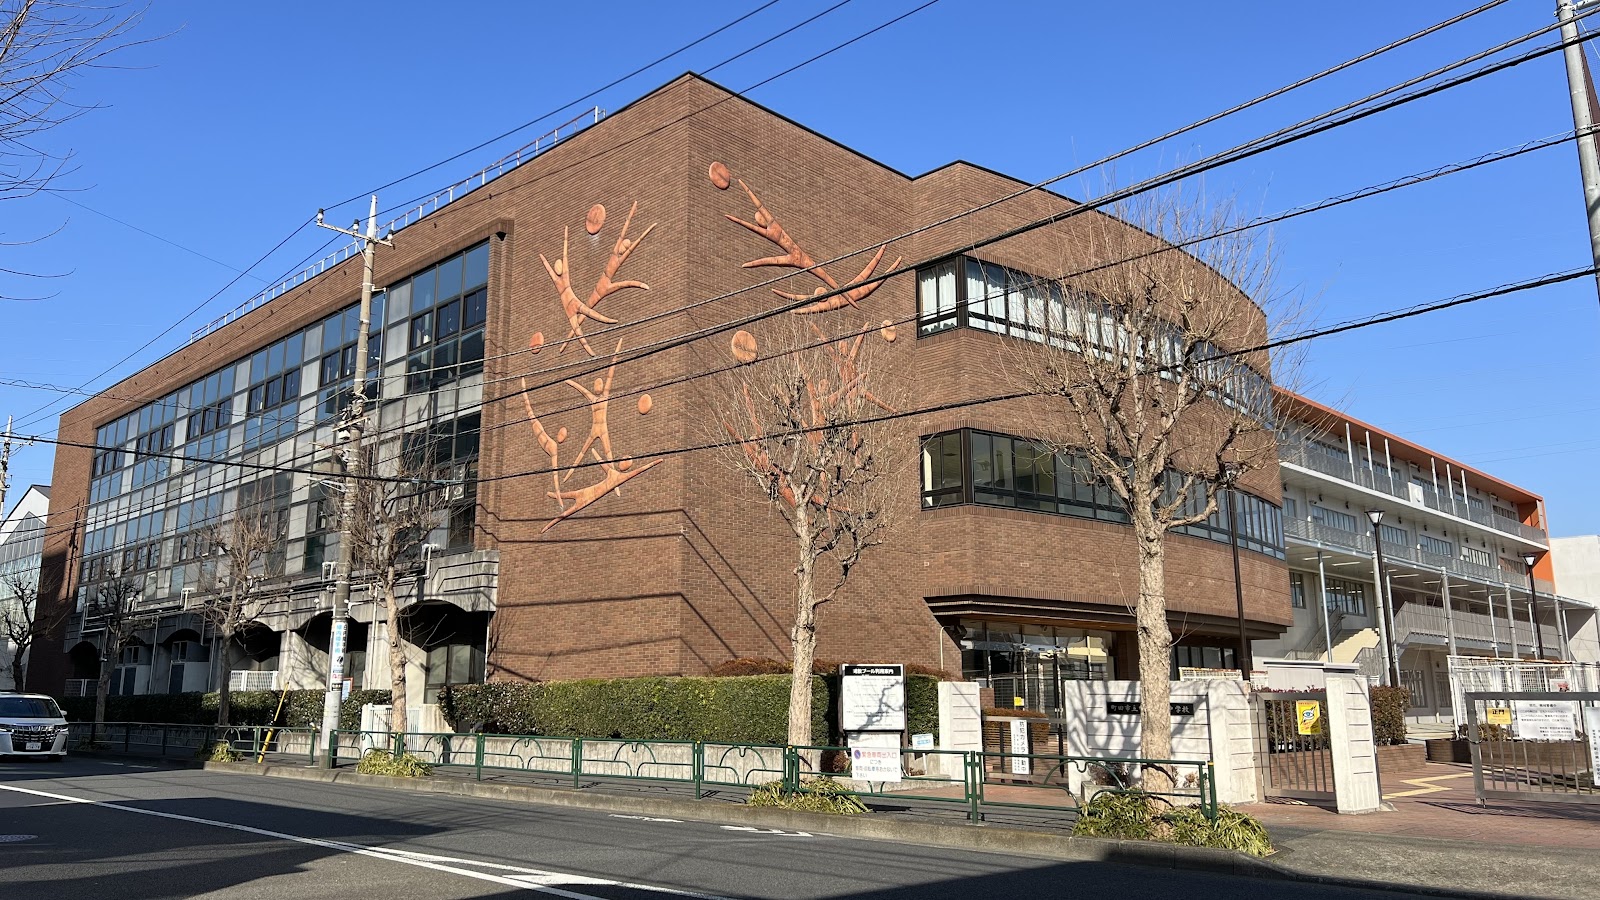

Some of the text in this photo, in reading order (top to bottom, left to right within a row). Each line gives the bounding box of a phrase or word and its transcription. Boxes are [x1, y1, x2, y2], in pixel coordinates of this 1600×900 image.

[1019, 721, 1027, 772] 防犯カメラ動中
